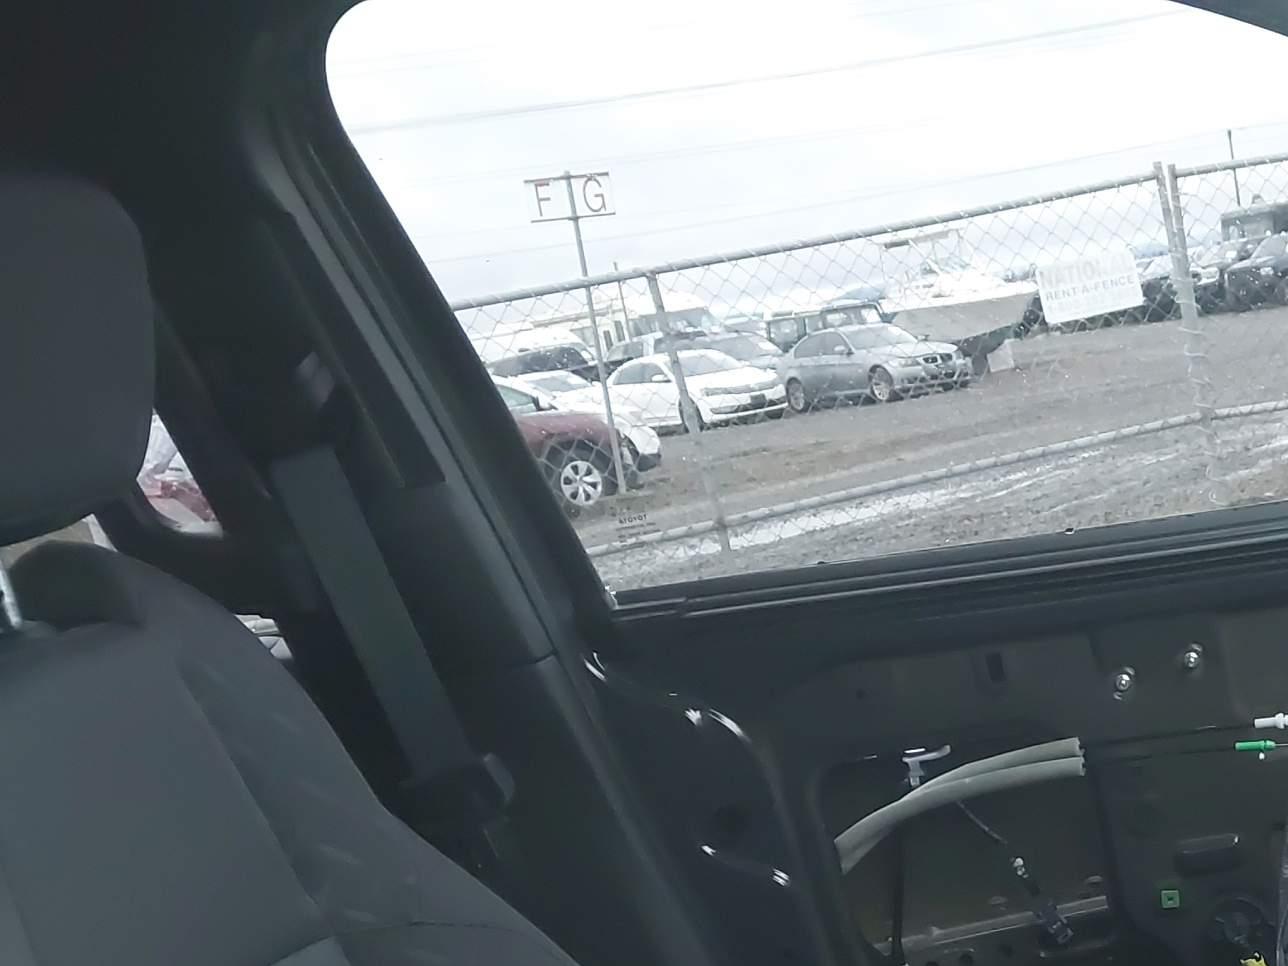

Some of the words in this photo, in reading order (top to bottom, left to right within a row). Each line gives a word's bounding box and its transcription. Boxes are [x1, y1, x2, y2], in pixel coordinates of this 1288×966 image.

[534, 182, 551, 217] F
[583, 177, 607, 213] G
[1039, 254, 1134, 290] NATIONAL
